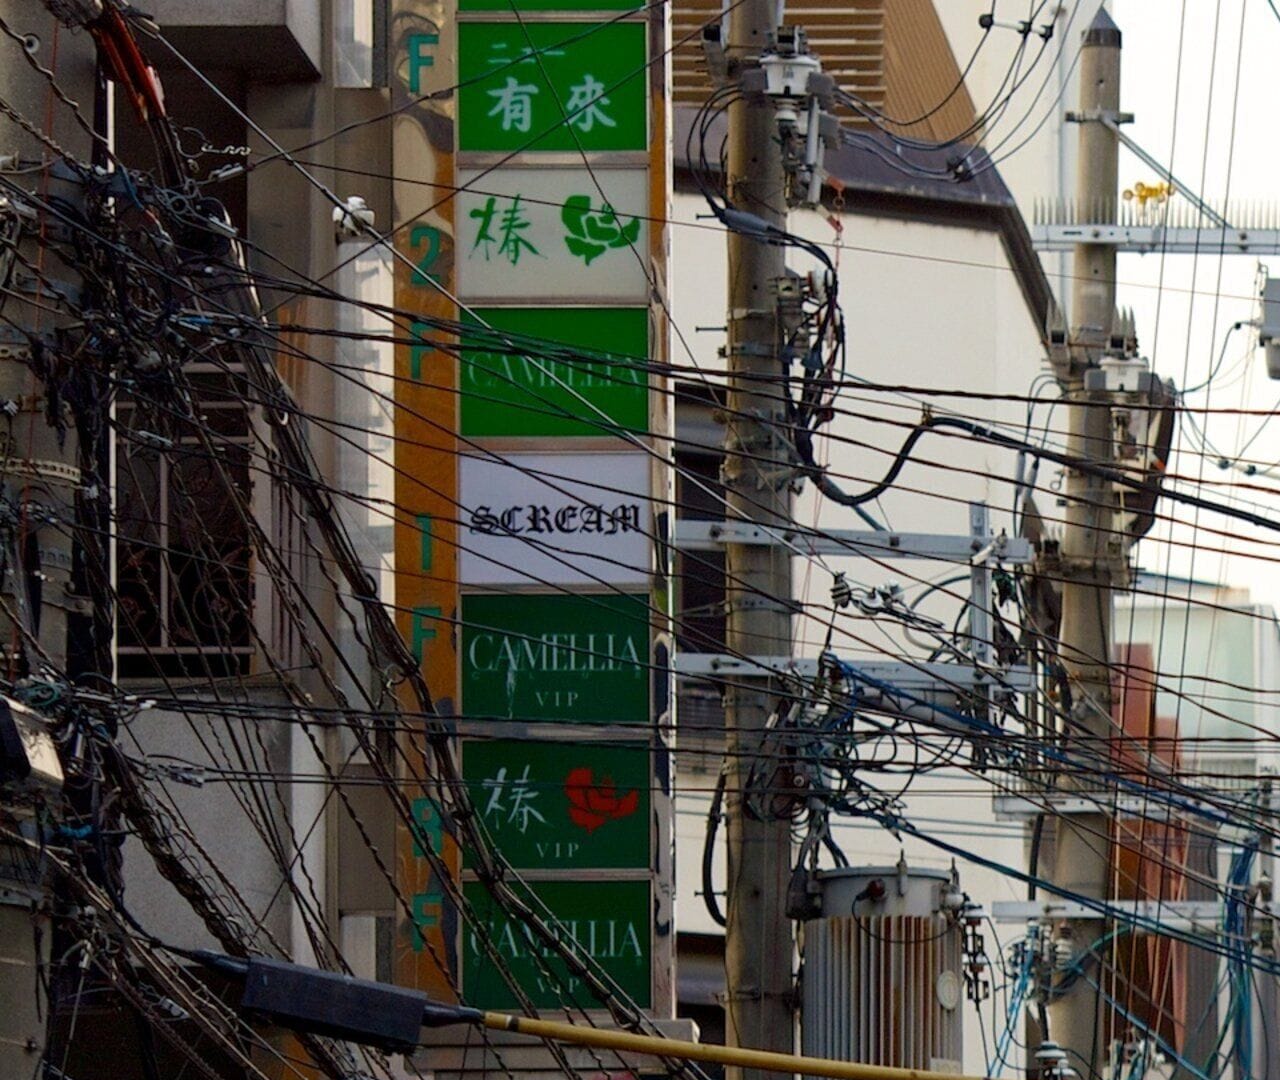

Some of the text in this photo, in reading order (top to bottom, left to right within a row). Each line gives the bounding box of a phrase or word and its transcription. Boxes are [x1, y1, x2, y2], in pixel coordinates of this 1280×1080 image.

[468, 193, 549, 267] 椿
[469, 504, 642, 535] SCREAM
[469, 633, 642, 672] CAMELLIA
[535, 691, 579, 707] VIP
[482, 764, 553, 836] 椿
[536, 842, 580, 858] VIP
